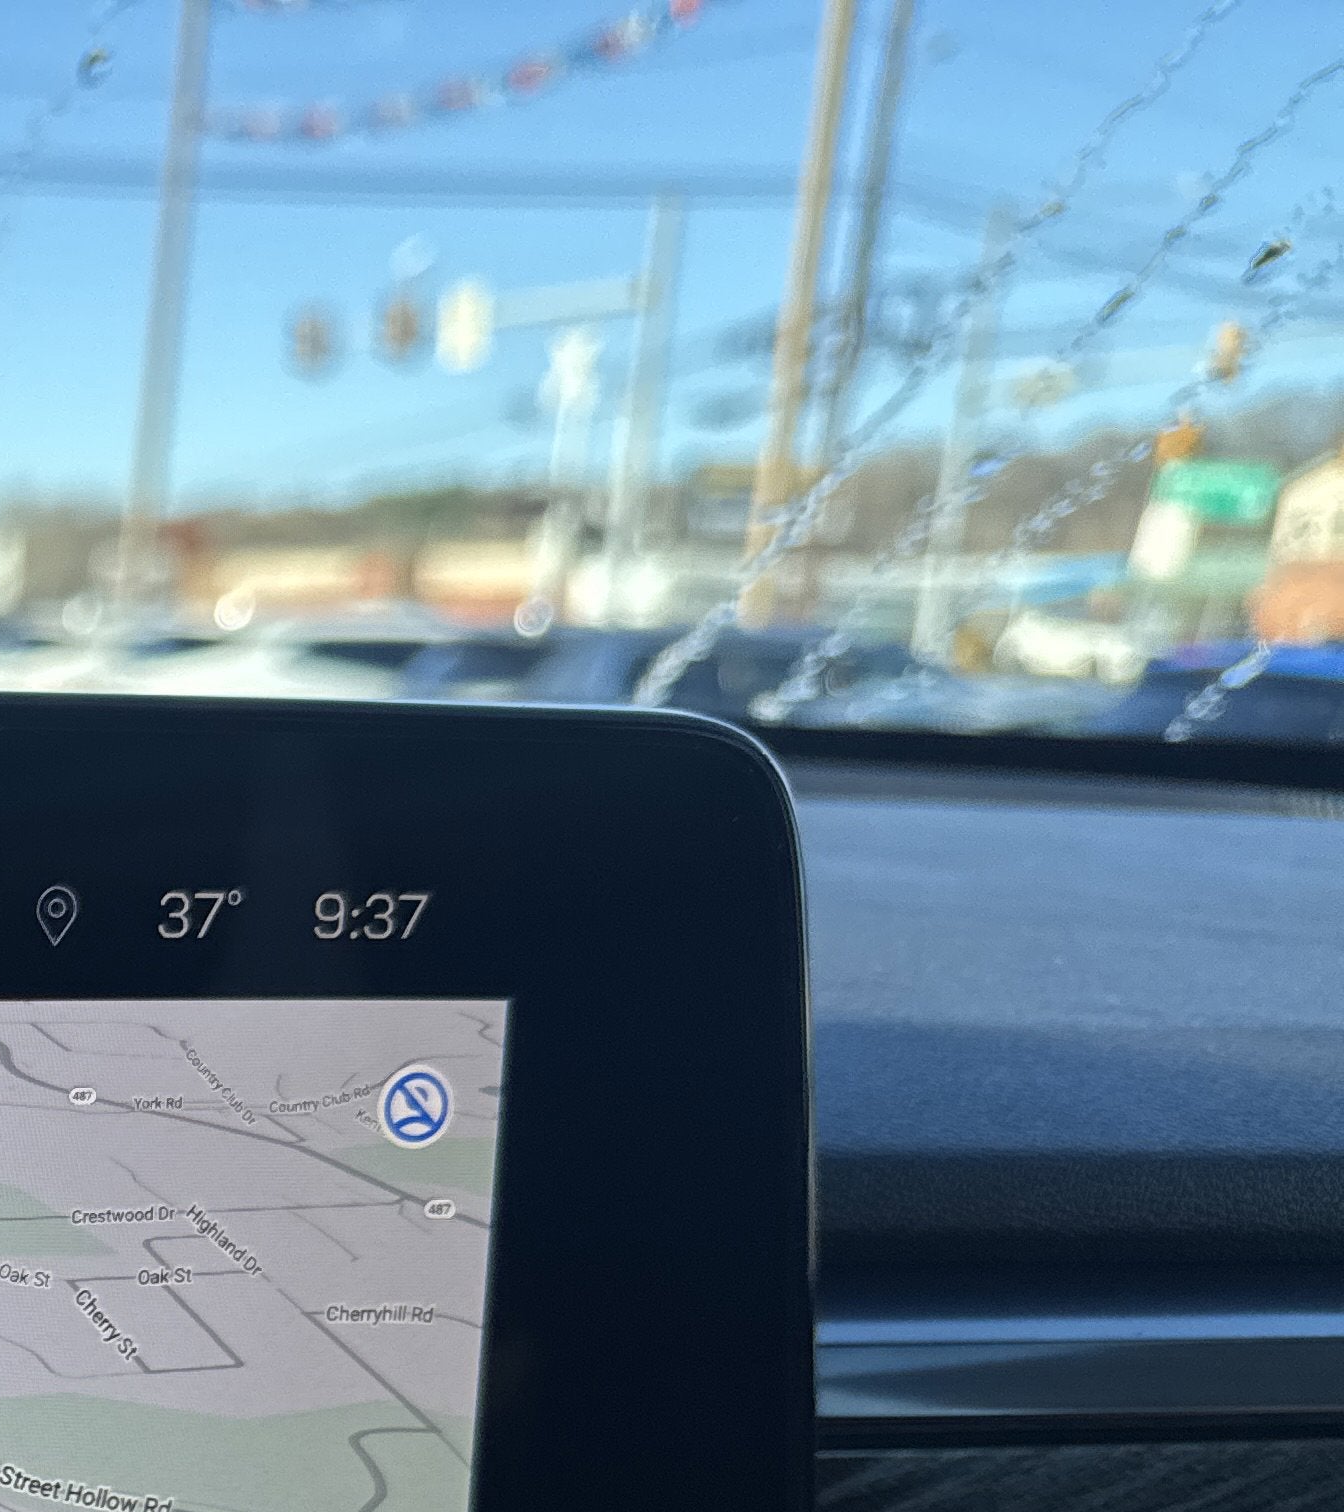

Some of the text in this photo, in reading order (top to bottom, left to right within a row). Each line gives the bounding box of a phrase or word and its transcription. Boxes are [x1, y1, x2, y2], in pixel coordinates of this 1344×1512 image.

[314, 893, 429, 940] 9:37
[72, 1091, 92, 1100] 487
[186, 1050, 256, 1126] Country Club Dr
[269, 1085, 371, 1114] Country Club Rd
[134, 1097, 182, 1109] York Rd
[71, 1206, 175, 1224] Crestwood Dr
[429, 1204, 451, 1215] 487
[186, 1204, 263, 1277] Highland Dr
[0, 1264, 51, 1288] Oak St
[138, 1267, 192, 1285] Oak St
[76, 1289, 138, 1360] Cherry St
[326, 1305, 434, 1324] Cherryhill Rd
[0, 1466, 60, 1498] Street
[66, 1484, 137, 1512] Hollow
